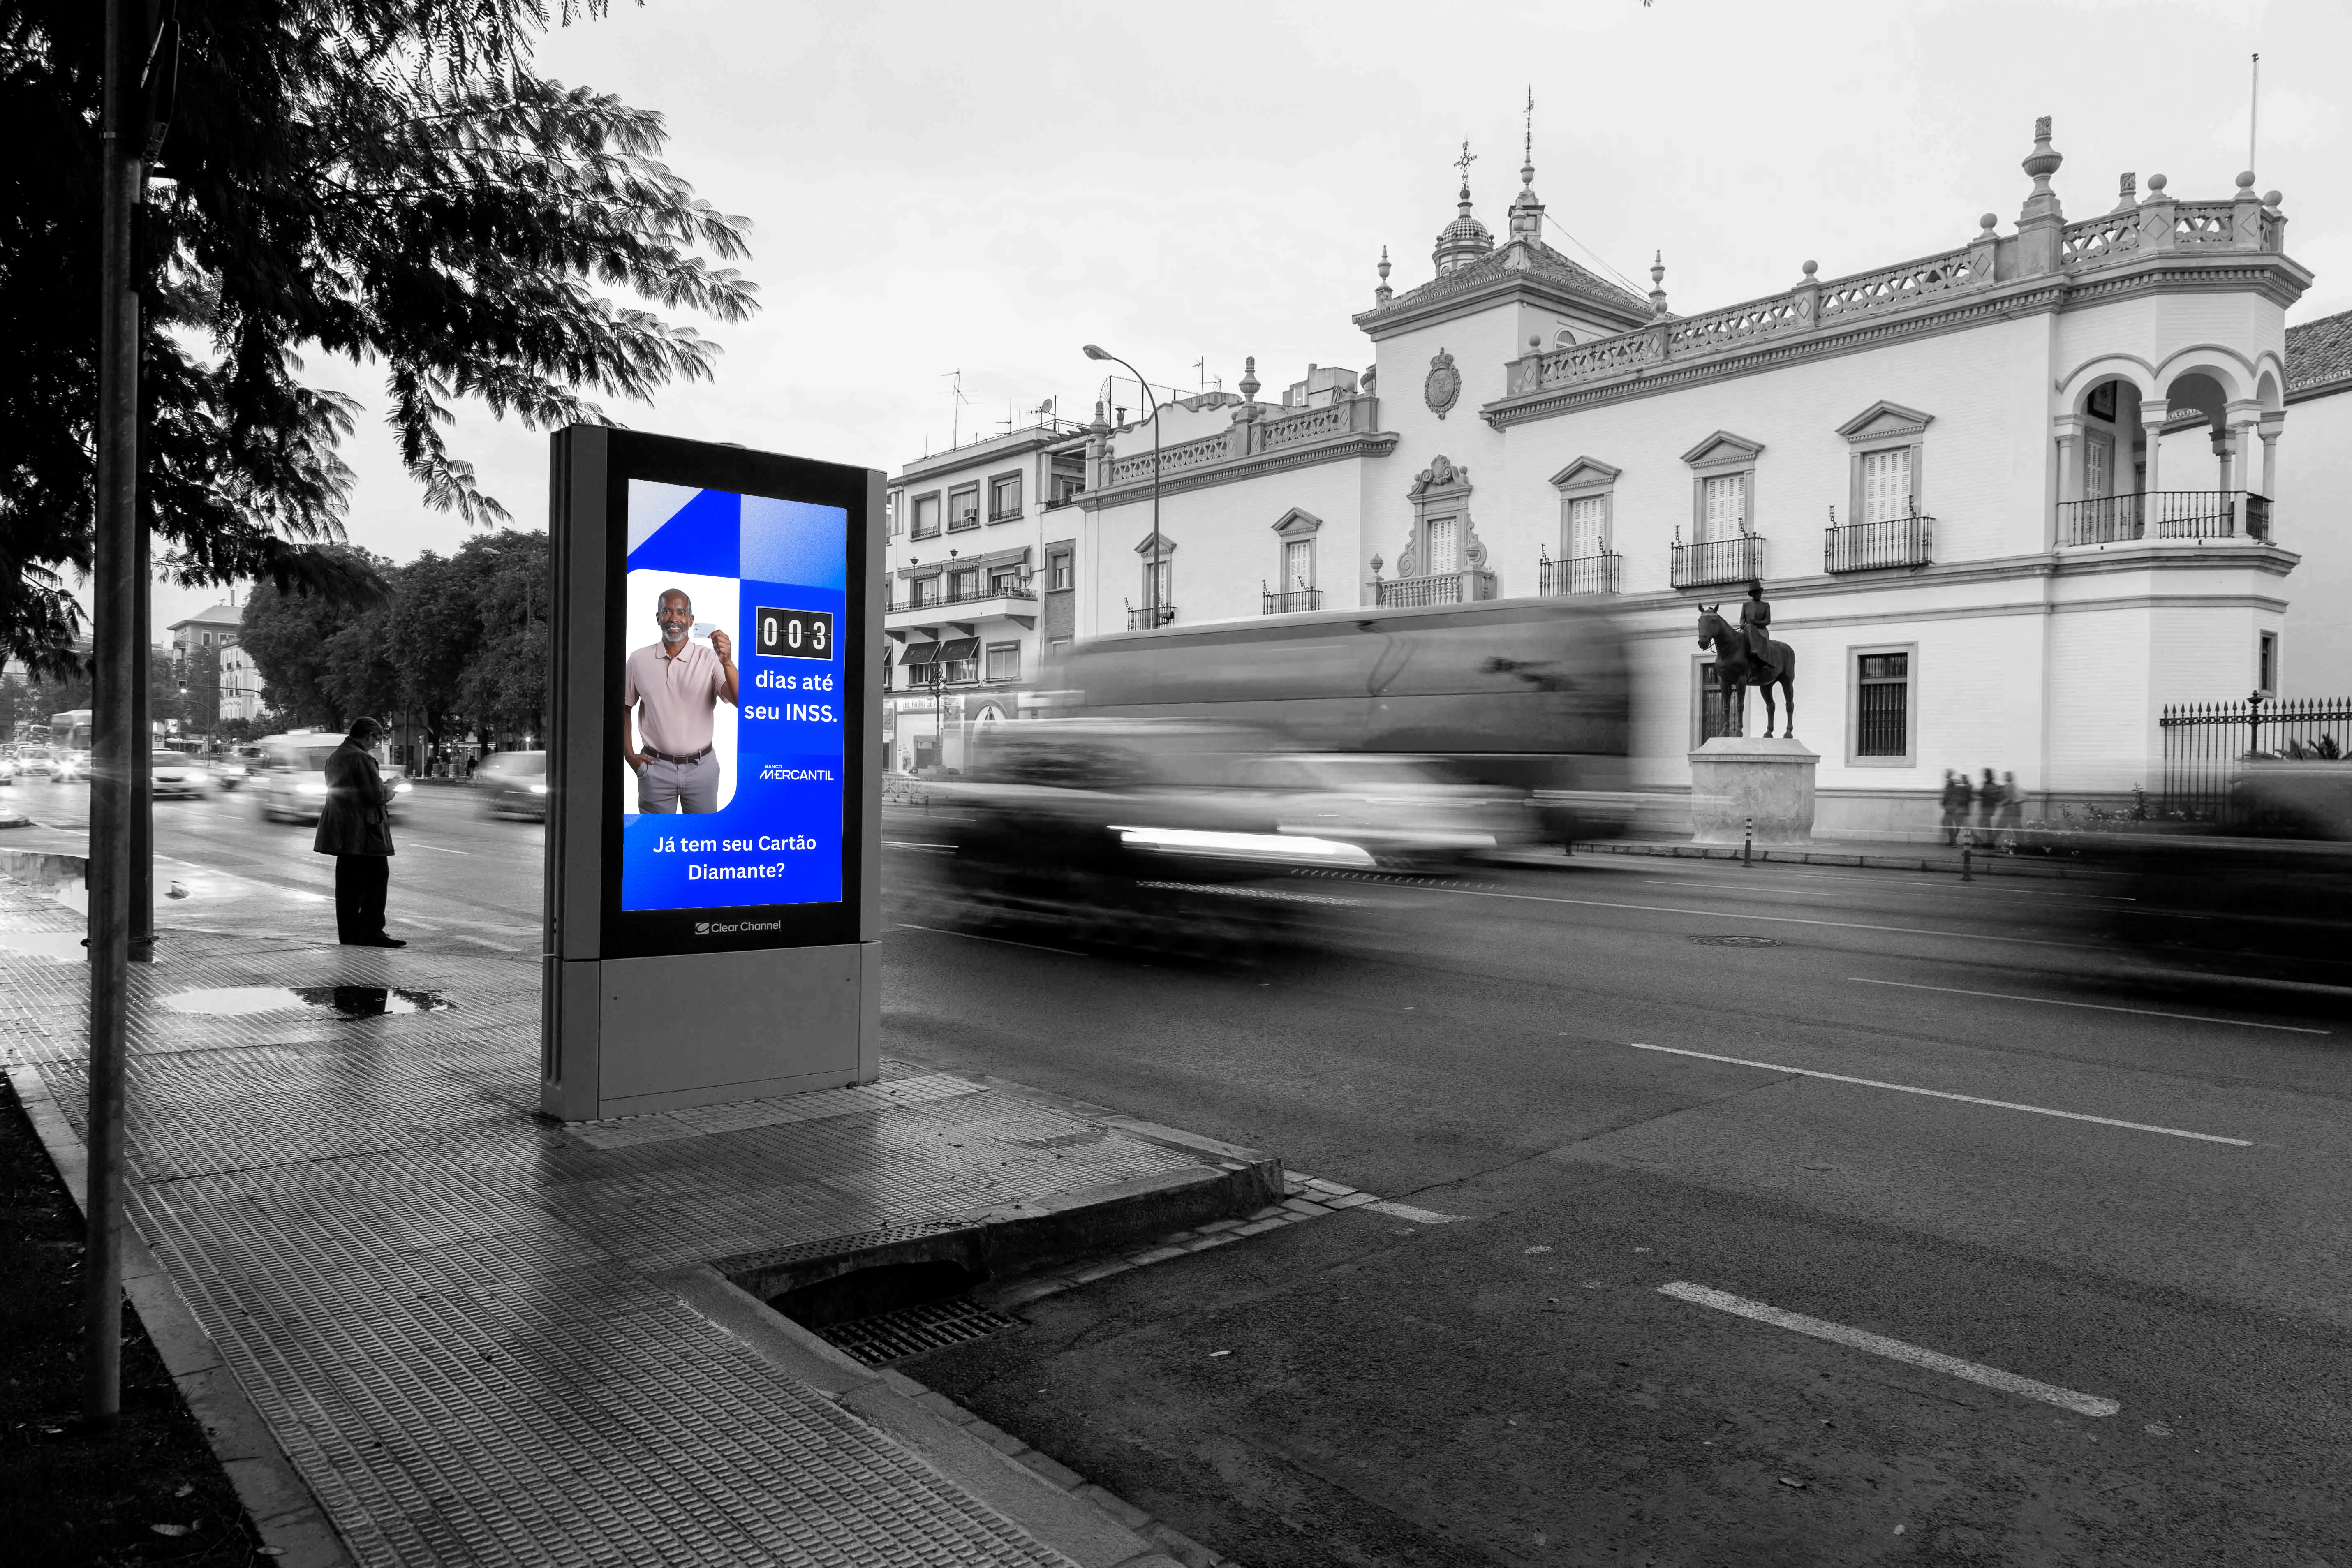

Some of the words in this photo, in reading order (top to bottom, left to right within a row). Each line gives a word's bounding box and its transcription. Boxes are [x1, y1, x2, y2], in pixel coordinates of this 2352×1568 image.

[764, 617, 826, 650] 003
[756, 670, 797, 689] dias
[802, 673, 833, 691] até
[744, 705, 779, 720] seu
[786, 703, 837, 722] INSS.
[759, 769, 834, 781] MERCANTIL
[653, 836, 676, 853] Já
[680, 838, 717, 852] tem
[722, 839, 753, 851] seu
[759, 835, 816, 851] Cartão
[689, 863, 785, 880] Diamante?
[711, 923, 739, 932] Clear
[740, 920, 781, 931] Channel
